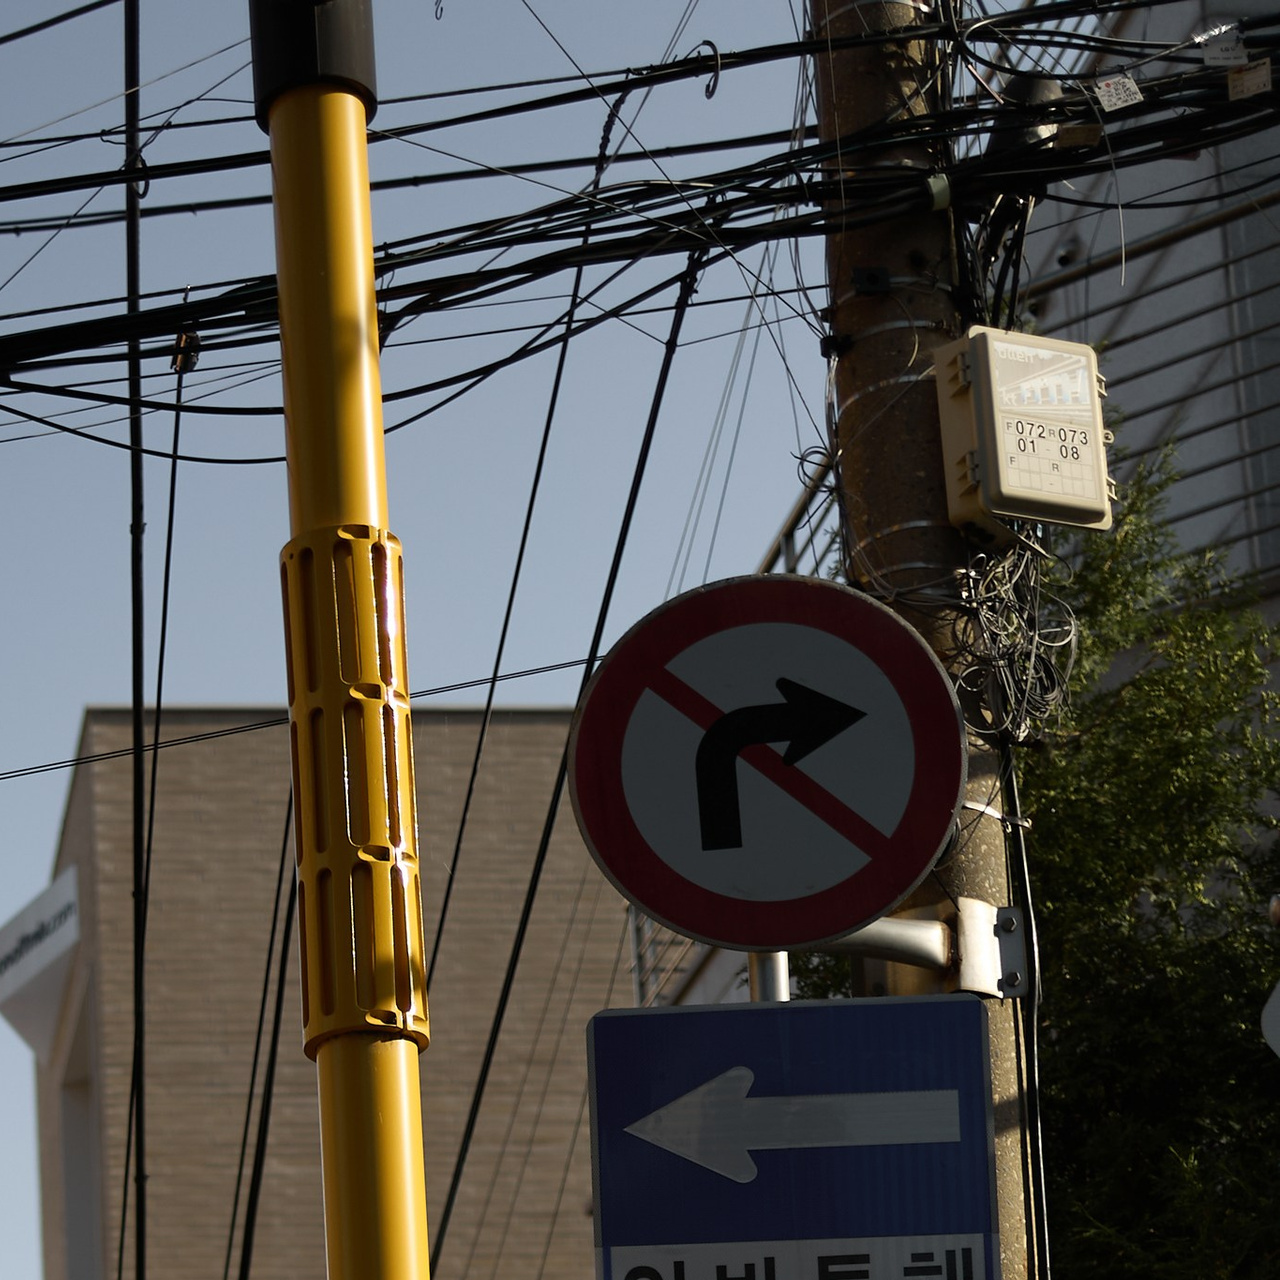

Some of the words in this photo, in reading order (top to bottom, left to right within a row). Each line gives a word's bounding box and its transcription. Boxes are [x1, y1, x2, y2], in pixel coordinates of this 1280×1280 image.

[1016, 420, 1046, 439] 072
[1058, 427, 1089, 446] 073
[1017, 437, 1036, 453] 01
[1059, 444, 1080, 461] 08
